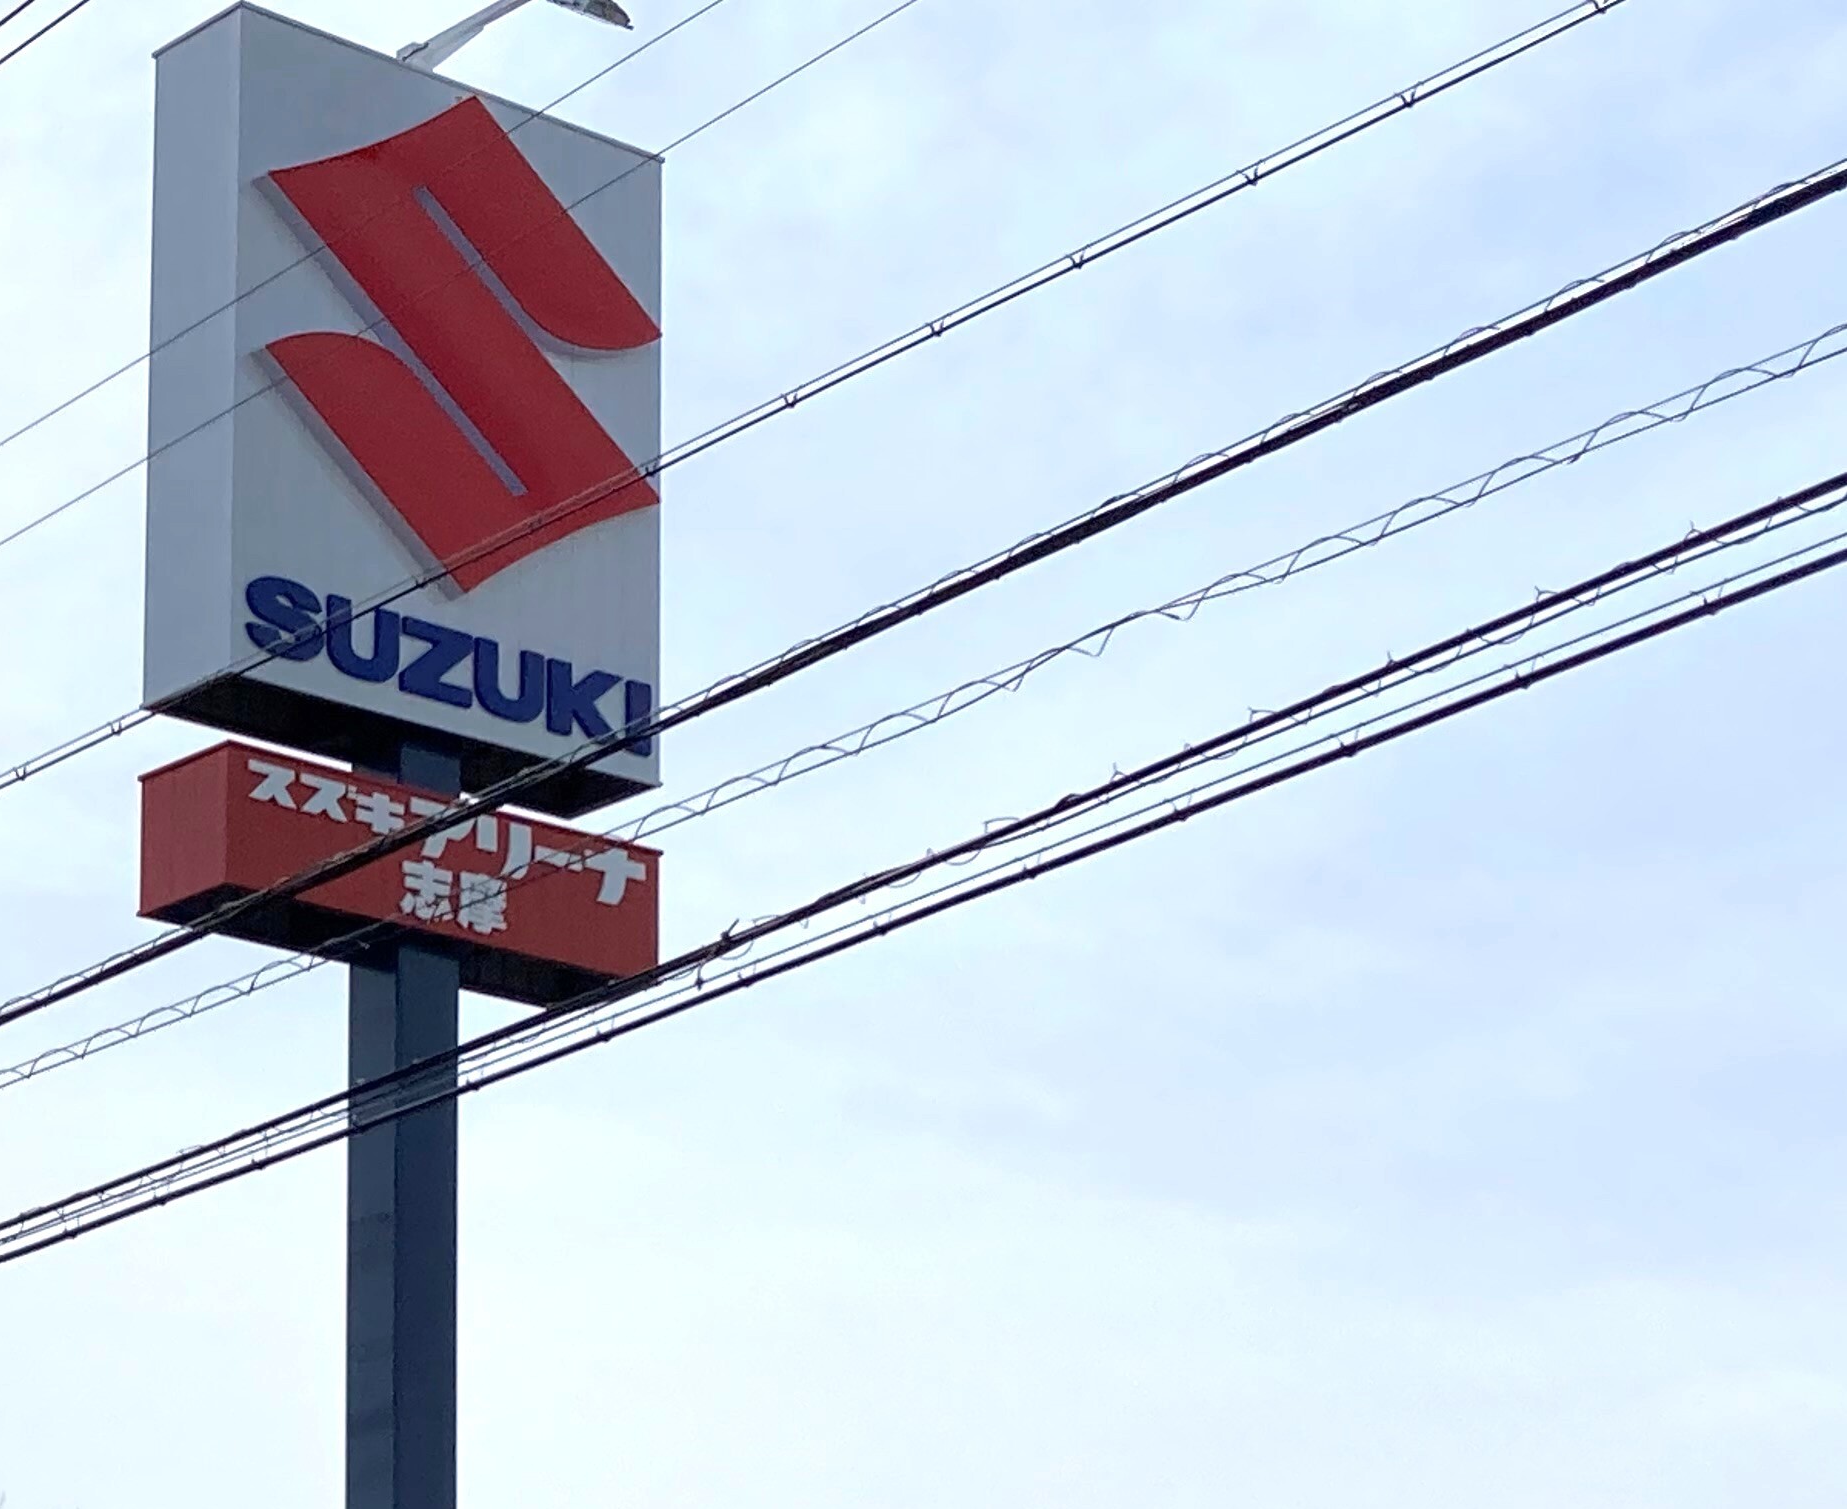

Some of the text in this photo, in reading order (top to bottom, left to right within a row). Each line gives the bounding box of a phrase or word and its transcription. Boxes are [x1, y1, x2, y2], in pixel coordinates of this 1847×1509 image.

[245, 576, 652, 757] SUZUKI
[248, 759, 647, 905] スズキアリーナ
[400, 860, 508, 935] 志摩
